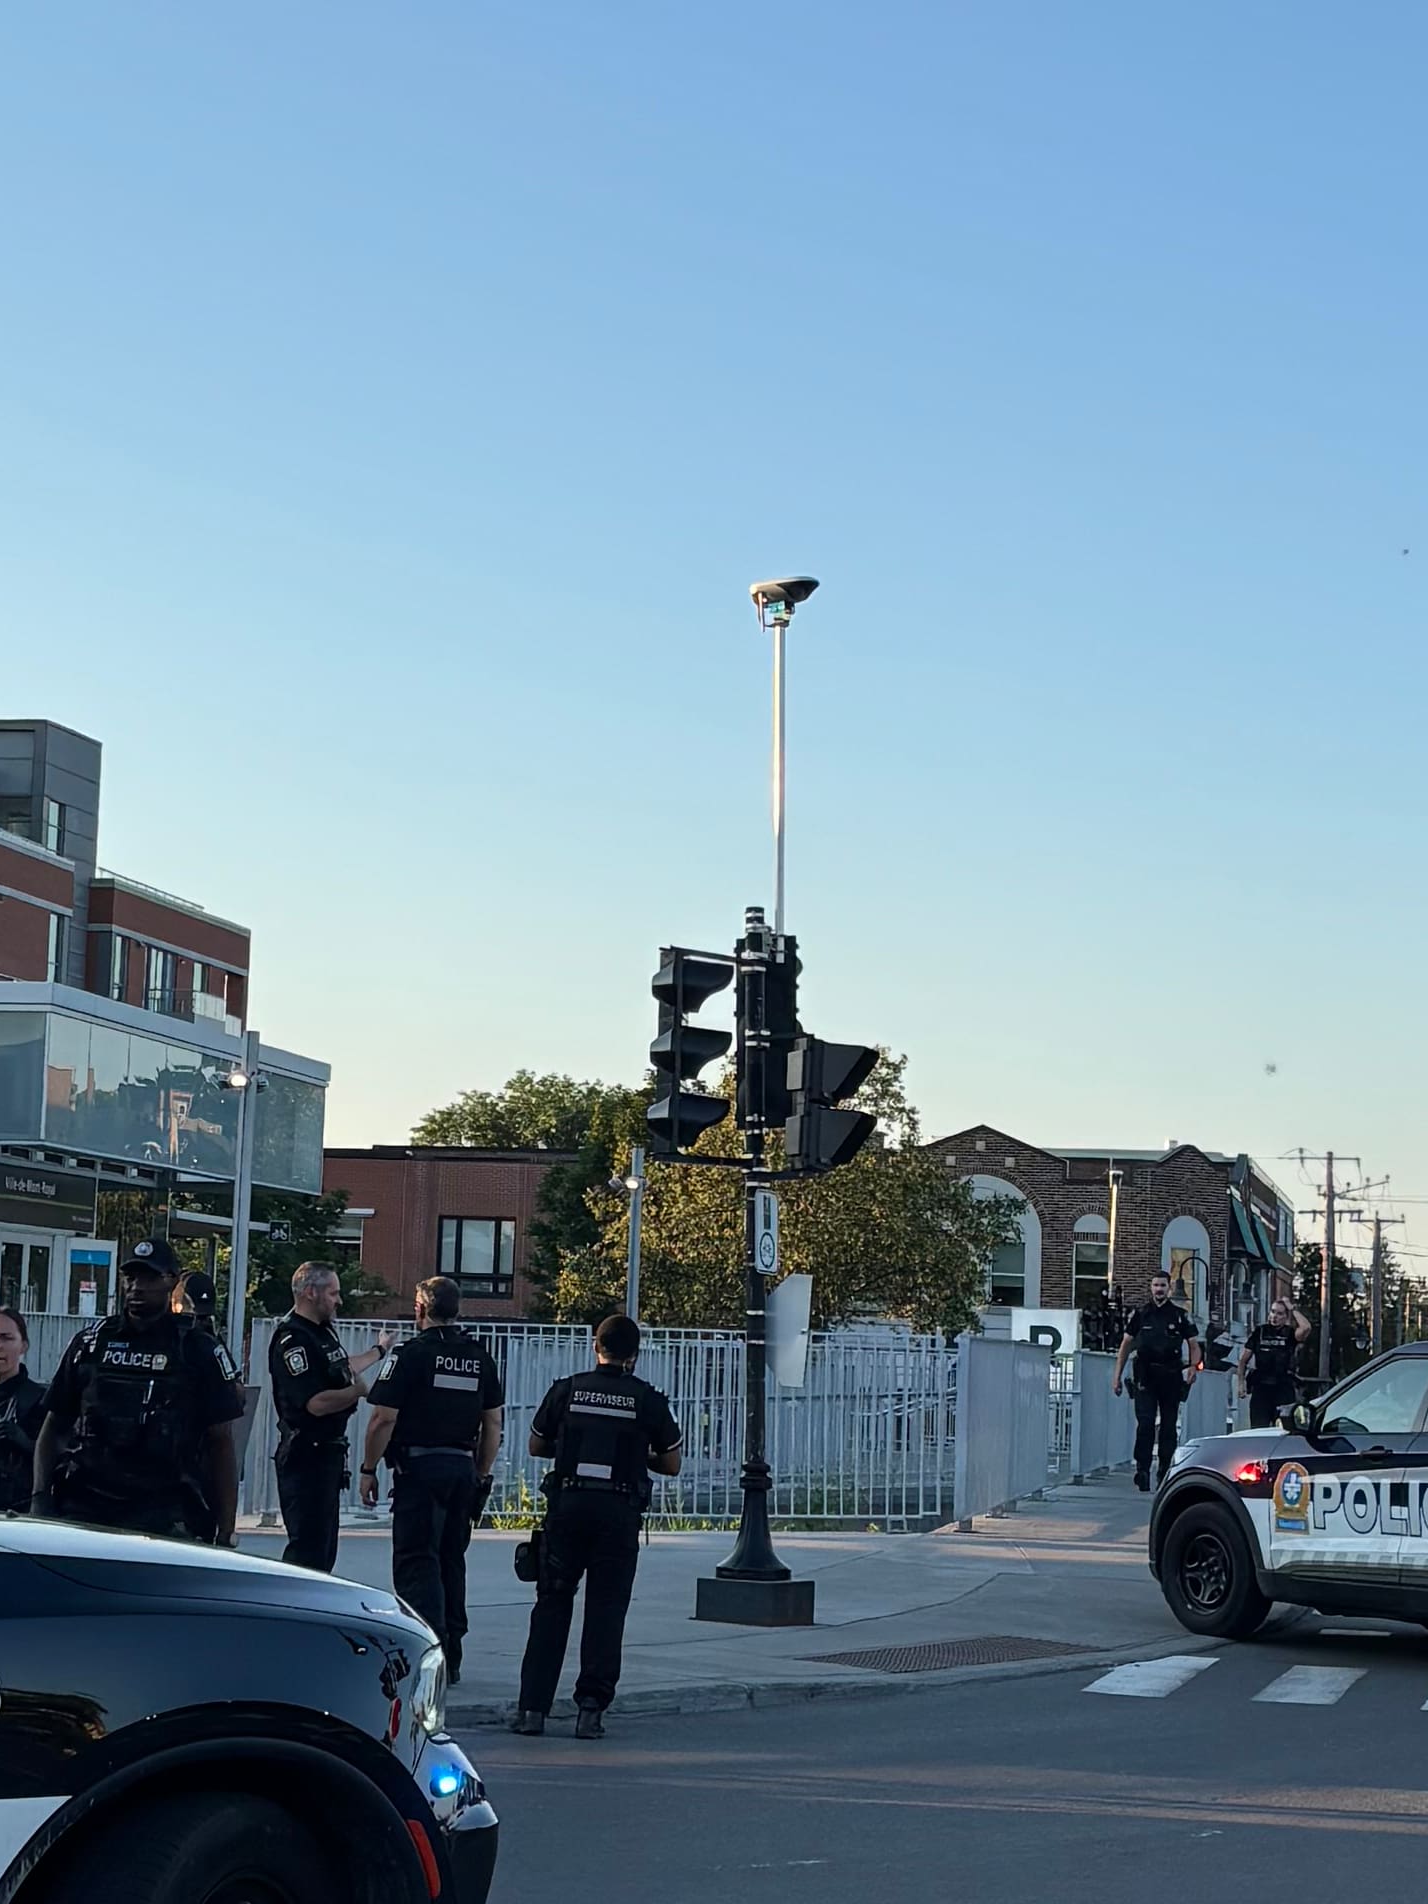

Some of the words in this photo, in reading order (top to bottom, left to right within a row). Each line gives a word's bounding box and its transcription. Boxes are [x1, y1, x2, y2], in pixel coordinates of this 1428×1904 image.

[103, 1350, 152, 1368] POLICE
[436, 1355, 481, 1374] POLICE
[574, 1390, 635, 1408] SUPERVISEUR
